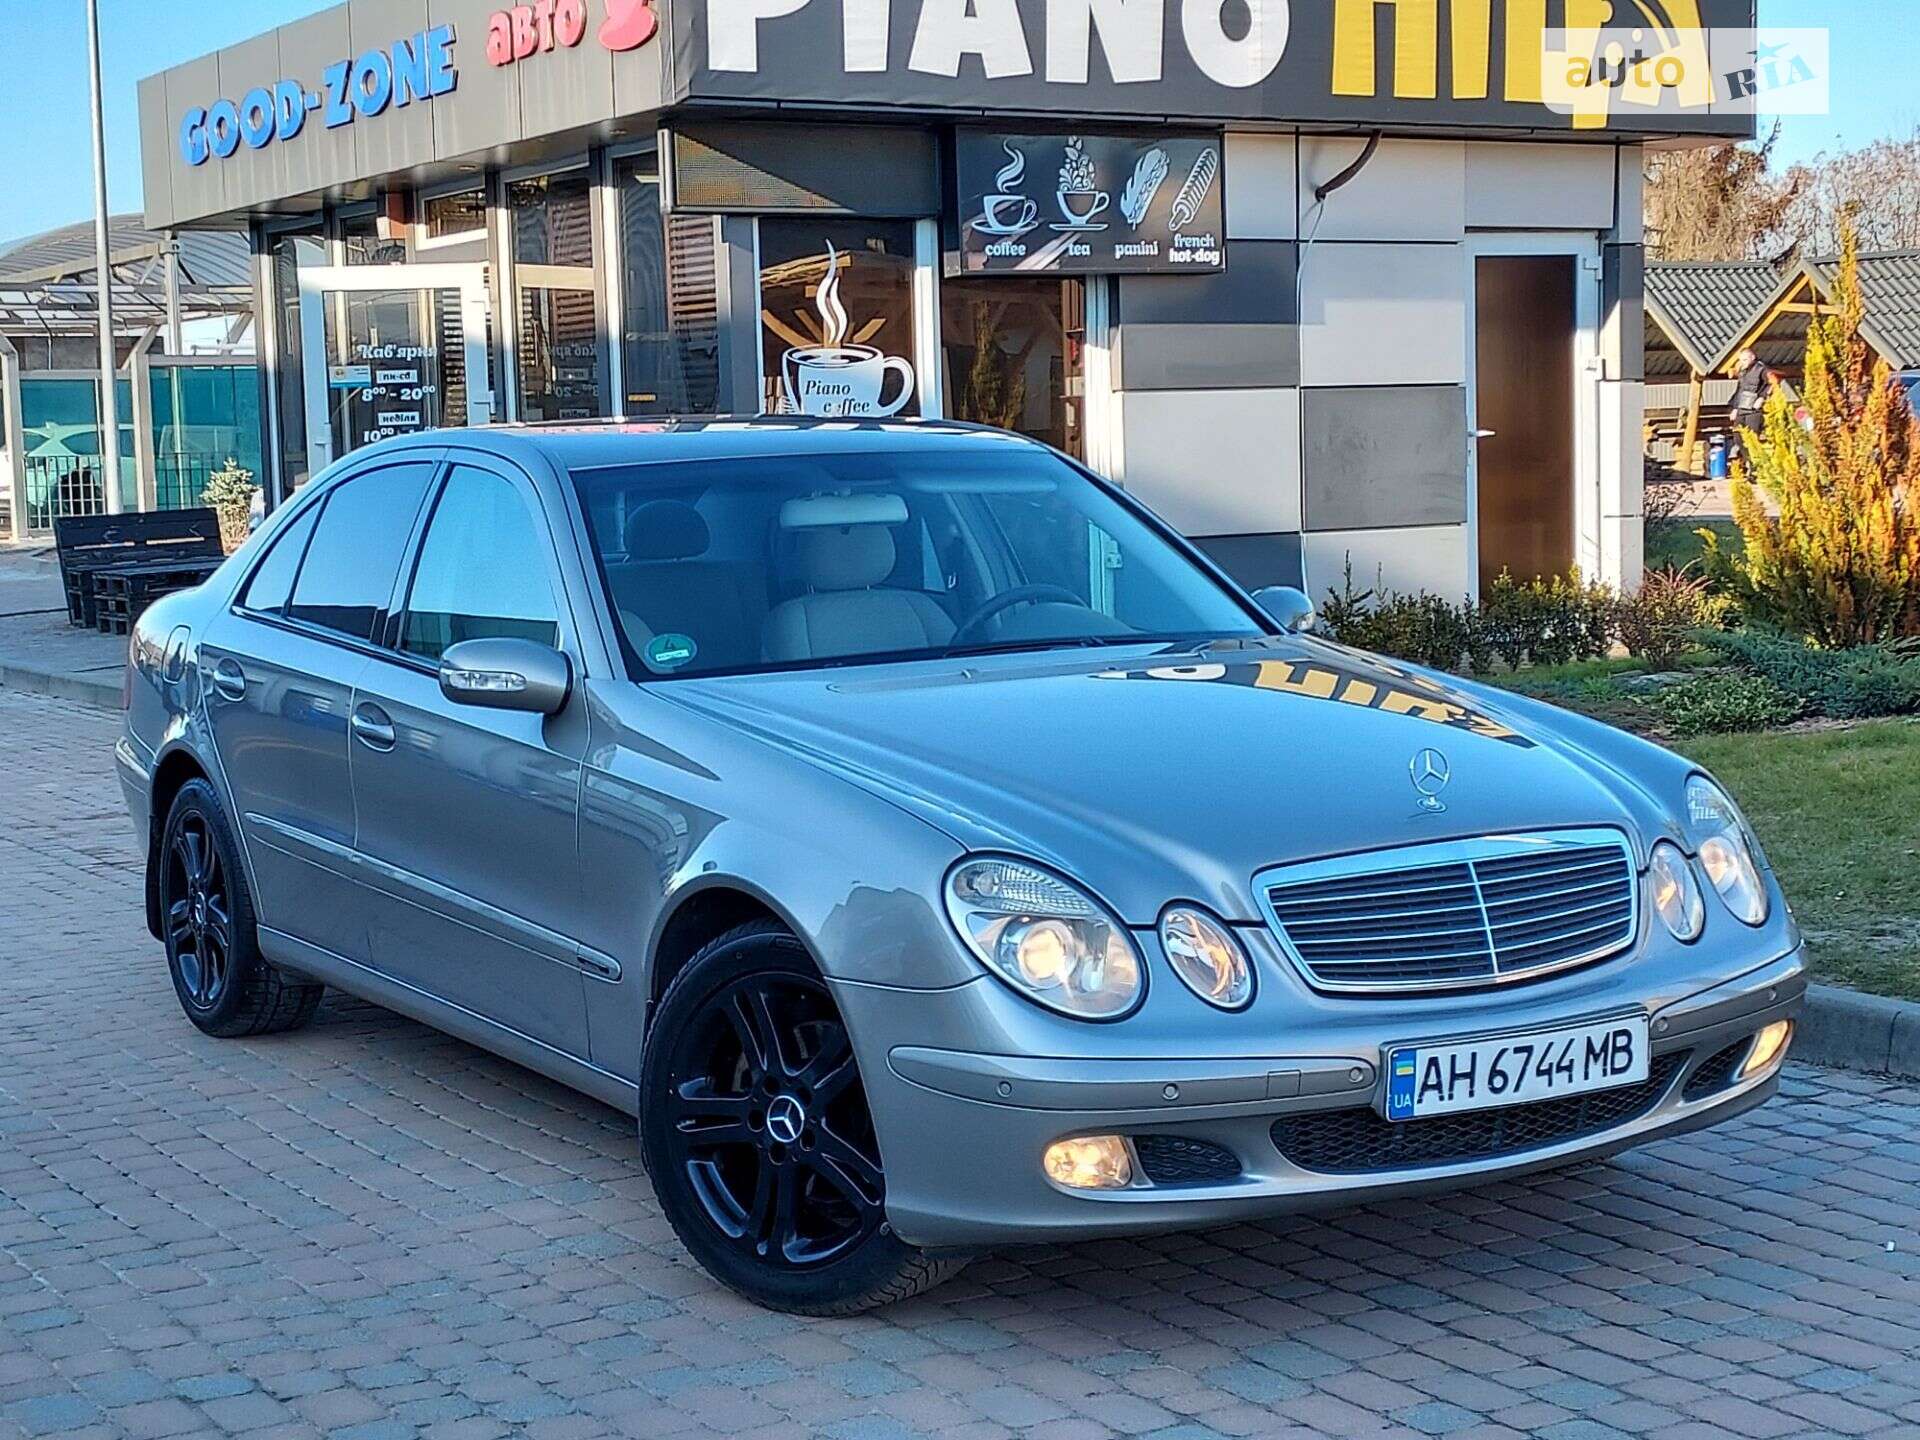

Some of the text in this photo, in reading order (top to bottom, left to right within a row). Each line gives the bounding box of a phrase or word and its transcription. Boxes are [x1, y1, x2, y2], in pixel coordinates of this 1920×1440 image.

[486, 0, 587, 66] авто
[707, 0, 1291, 88] PIANO
[179, 23, 459, 166] GOOD-ZONE
[984, 241, 1027, 256] coffee
[1068, 242, 1091, 256] tea
[1114, 240, 1160, 259] panini
[1173, 233, 1215, 248] french
[1168, 247, 1220, 265] hot-dog
[805, 380, 851, 396] Piano
[823, 397, 870, 416] cffee
[1417, 1028, 1633, 1104] AH 6744 MB
[1393, 1094, 1412, 1109] UA
